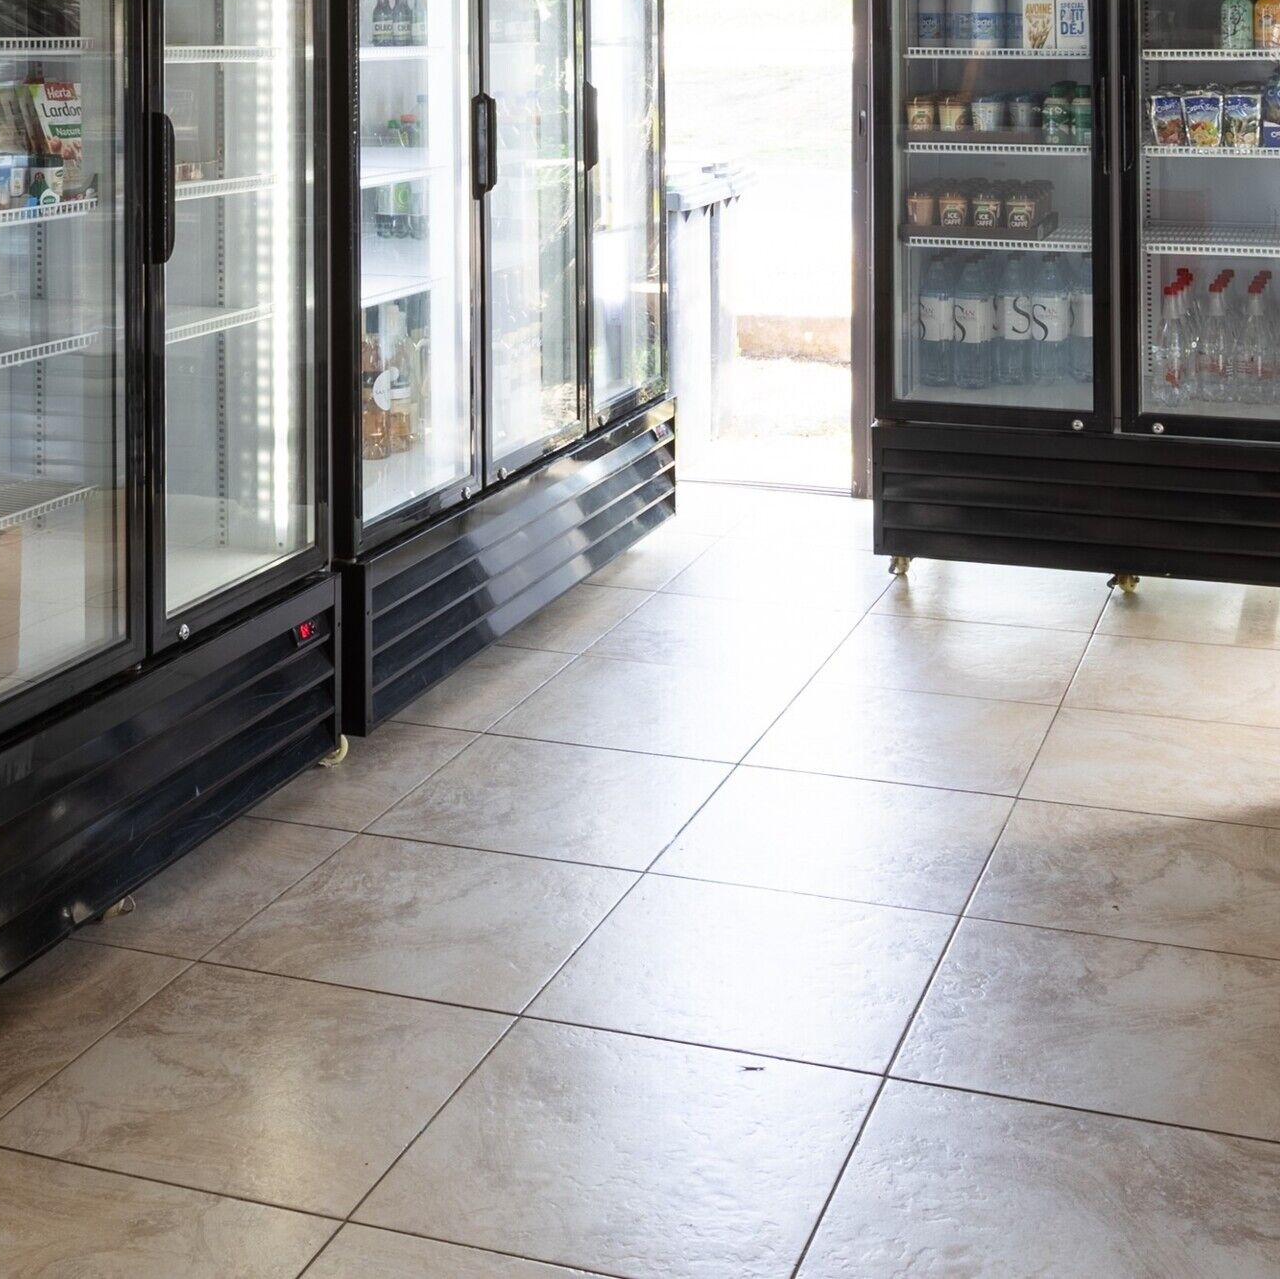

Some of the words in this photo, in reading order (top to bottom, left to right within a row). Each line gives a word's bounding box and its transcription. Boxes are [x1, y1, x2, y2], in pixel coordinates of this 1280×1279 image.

[1025, 3, 1052, 15] AVOINE
[1060, 21, 1085, 35] DÉJ
[47, 87, 73, 99] Herta
[41, 102, 82, 118] Lardon
